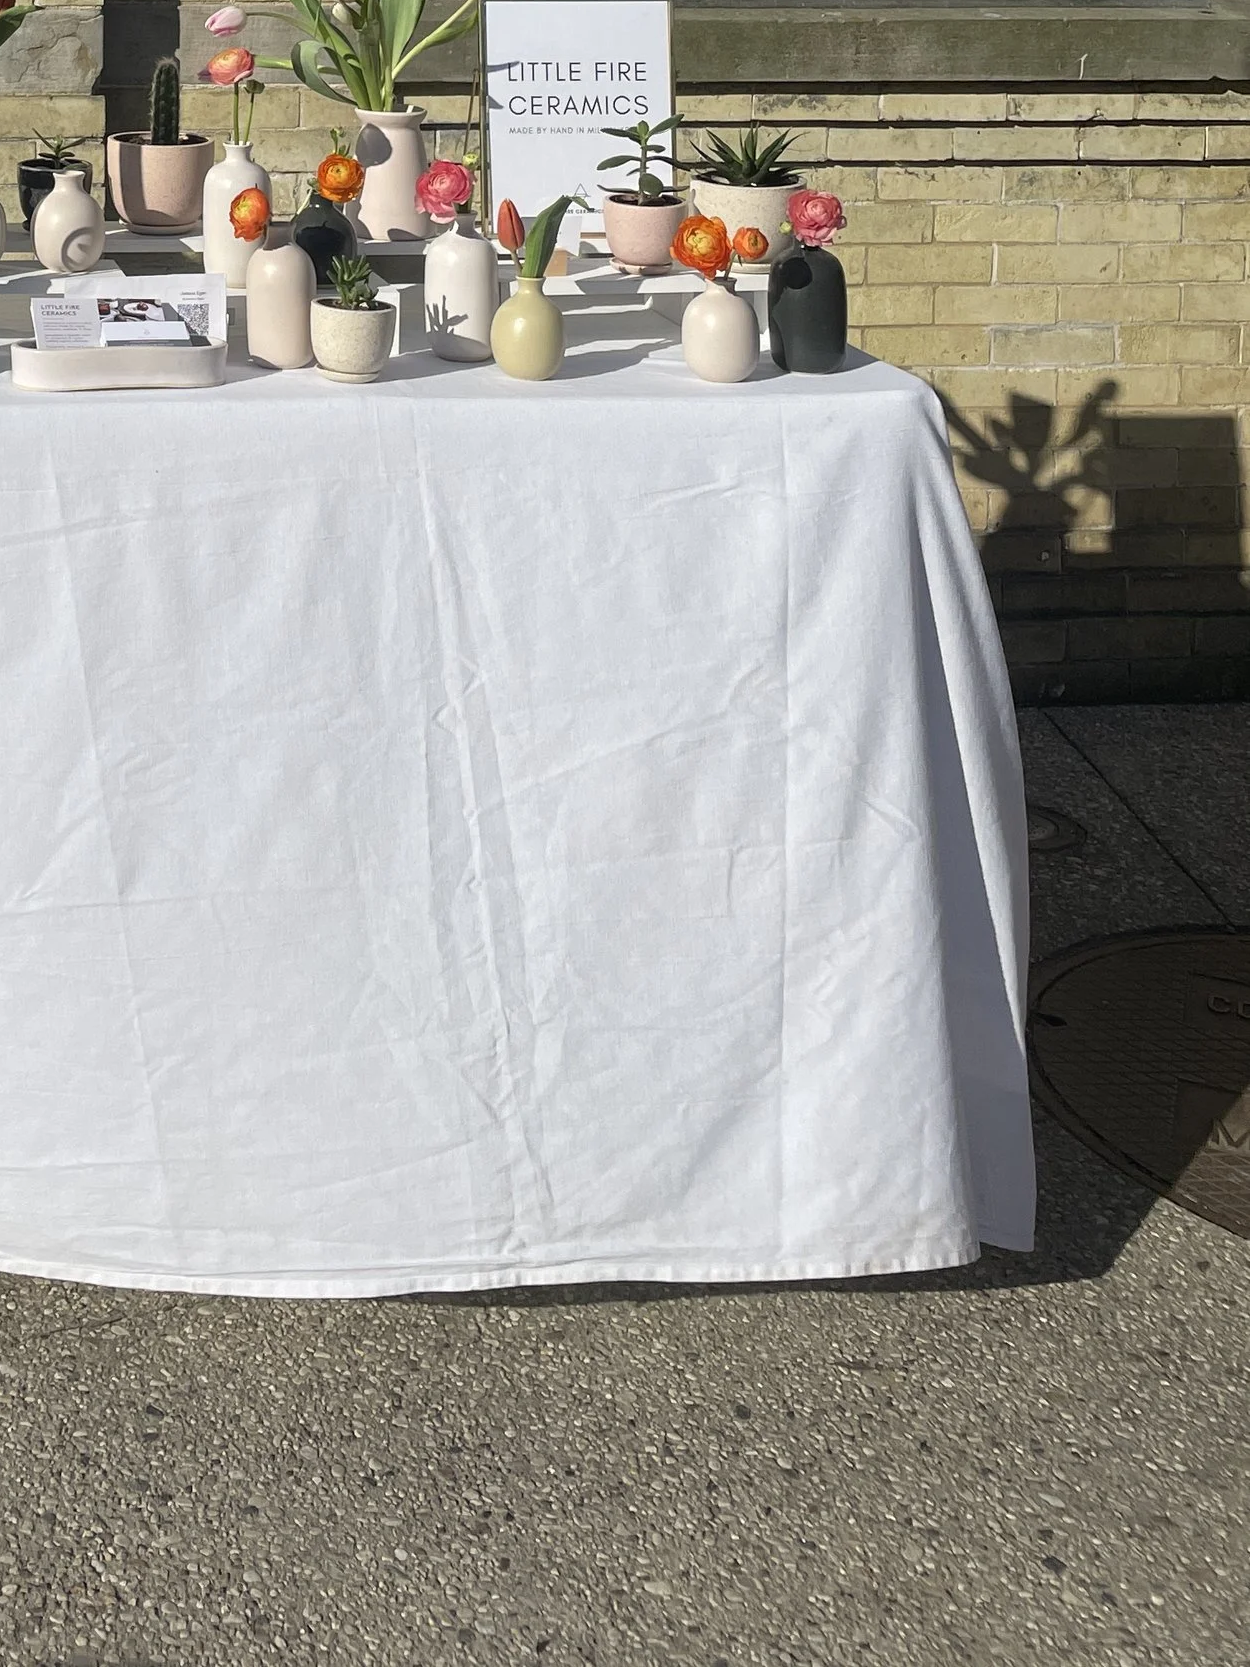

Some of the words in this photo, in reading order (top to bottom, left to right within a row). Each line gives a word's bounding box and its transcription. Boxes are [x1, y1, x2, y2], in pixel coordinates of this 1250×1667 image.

[507, 62, 582, 82] LITTLE
[594, 62, 648, 82] FIRE
[508, 95, 649, 116] CERAMICS
[509, 126, 534, 135] MADE
[536, 126, 548, 135] BY
[550, 126, 574, 135] HAND
[576, 126, 585, 135] IN
